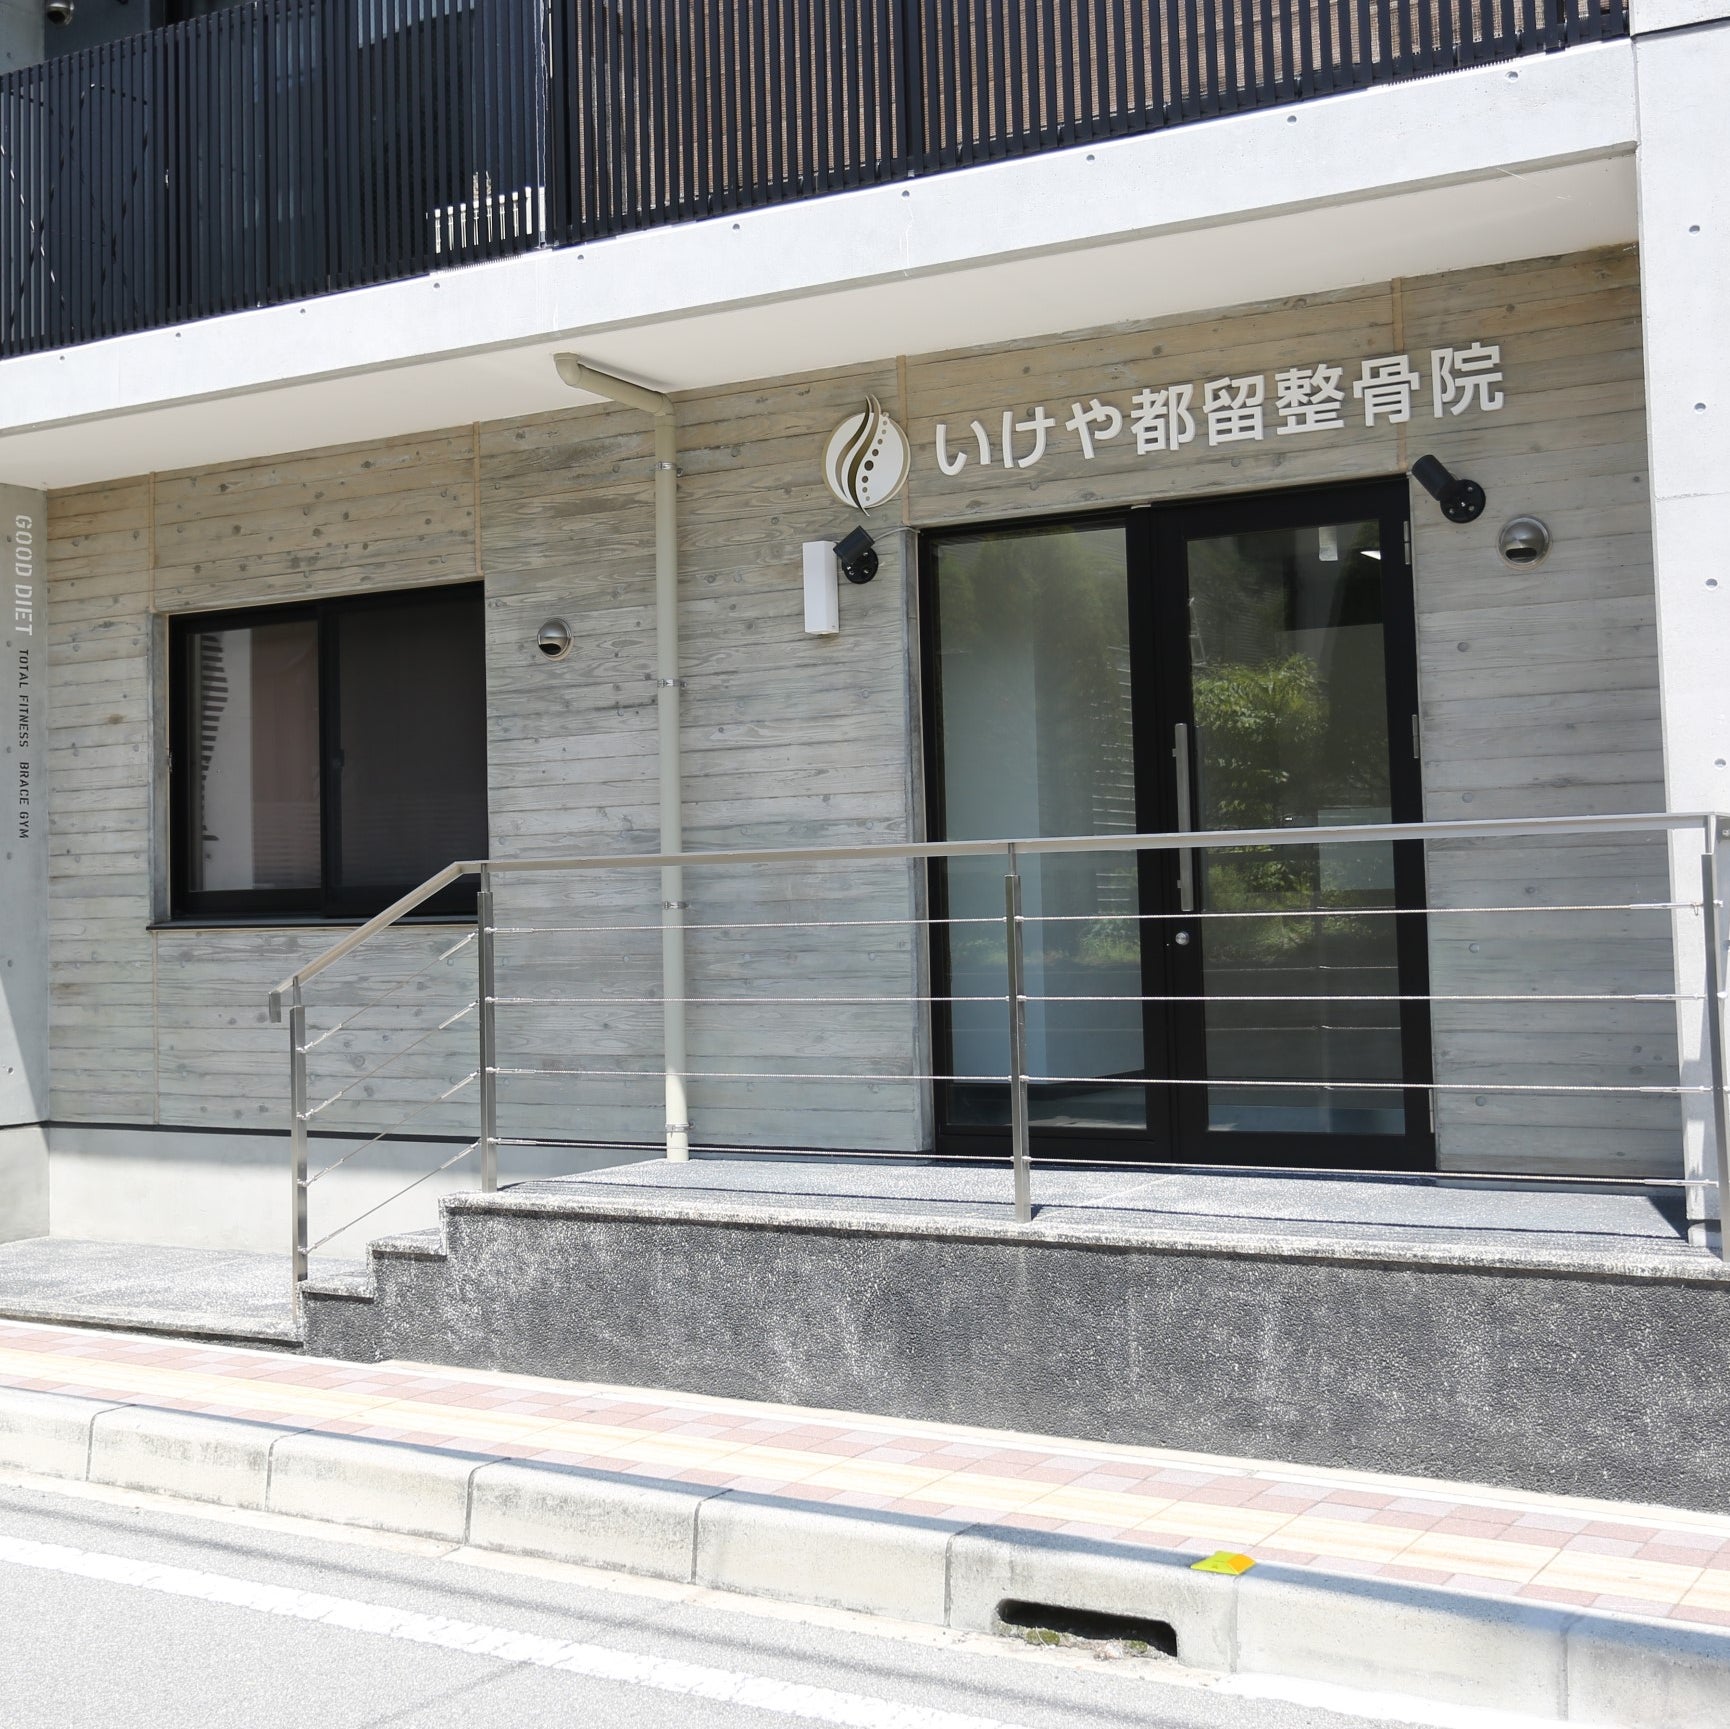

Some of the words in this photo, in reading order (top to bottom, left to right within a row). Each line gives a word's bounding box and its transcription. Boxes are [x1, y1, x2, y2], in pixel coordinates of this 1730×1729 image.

[935, 341, 1506, 477] いけや都留整骨院
[15, 514, 33, 577] GOOD
[15, 584, 33, 636] DIET
[18, 649, 29, 688] TOTAL
[18, 695, 29, 748] FITNESS
[19, 762, 30, 805] BRACE
[19, 811, 30, 839] GYM
